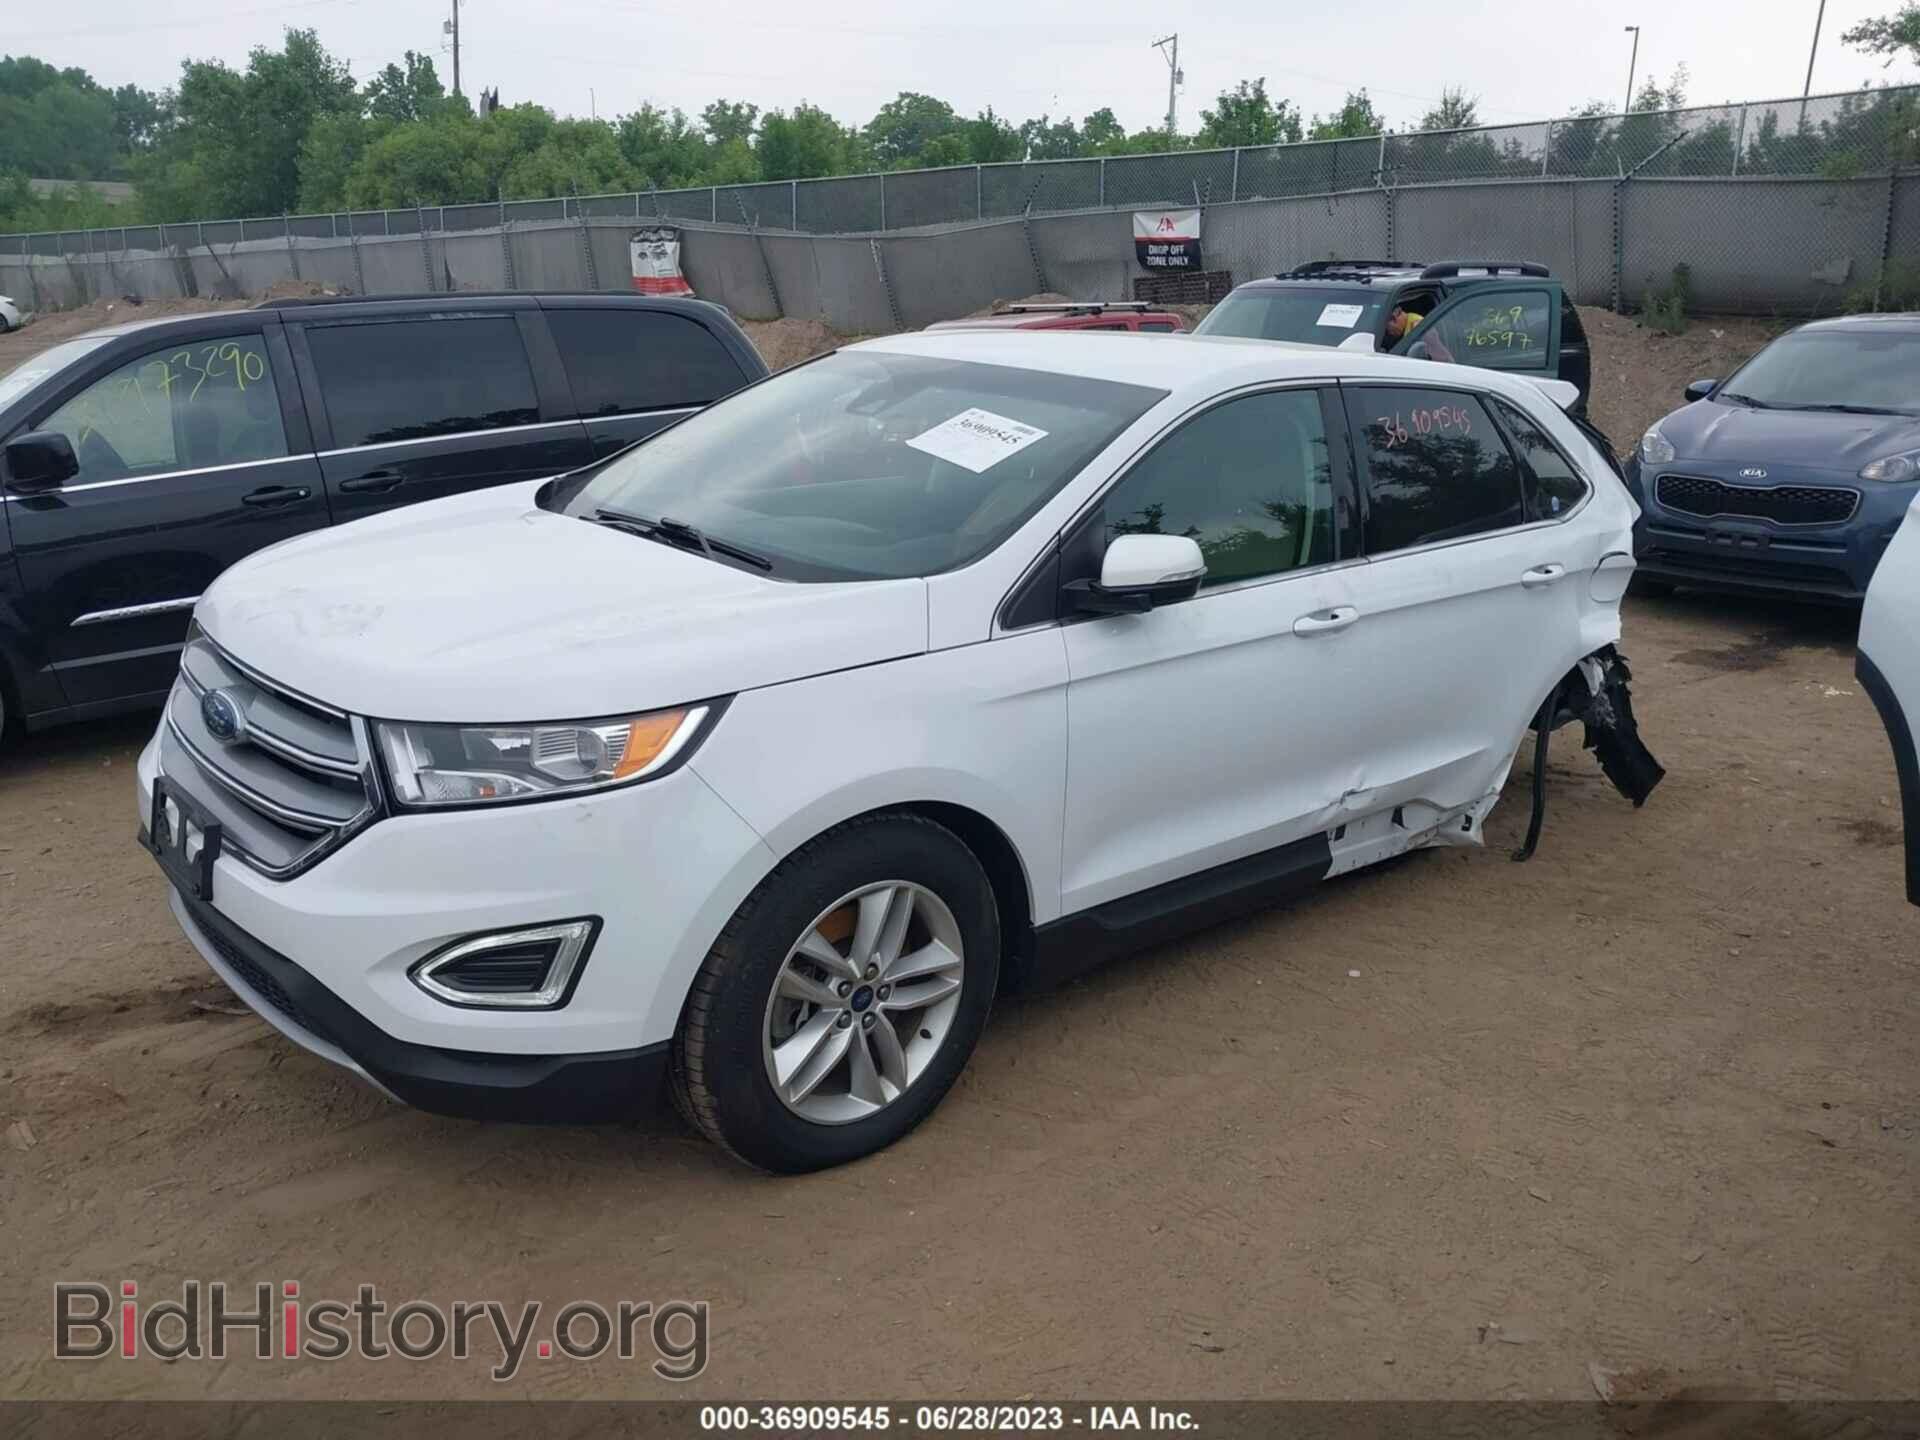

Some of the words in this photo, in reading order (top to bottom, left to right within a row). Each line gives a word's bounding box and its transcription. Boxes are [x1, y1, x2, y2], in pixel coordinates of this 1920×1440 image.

[1148, 245, 1169, 255] DROP
[1170, 245, 1185, 255] OFF
[1147, 256, 1167, 266] ZONE
[1168, 256, 1189, 266] ONLY
